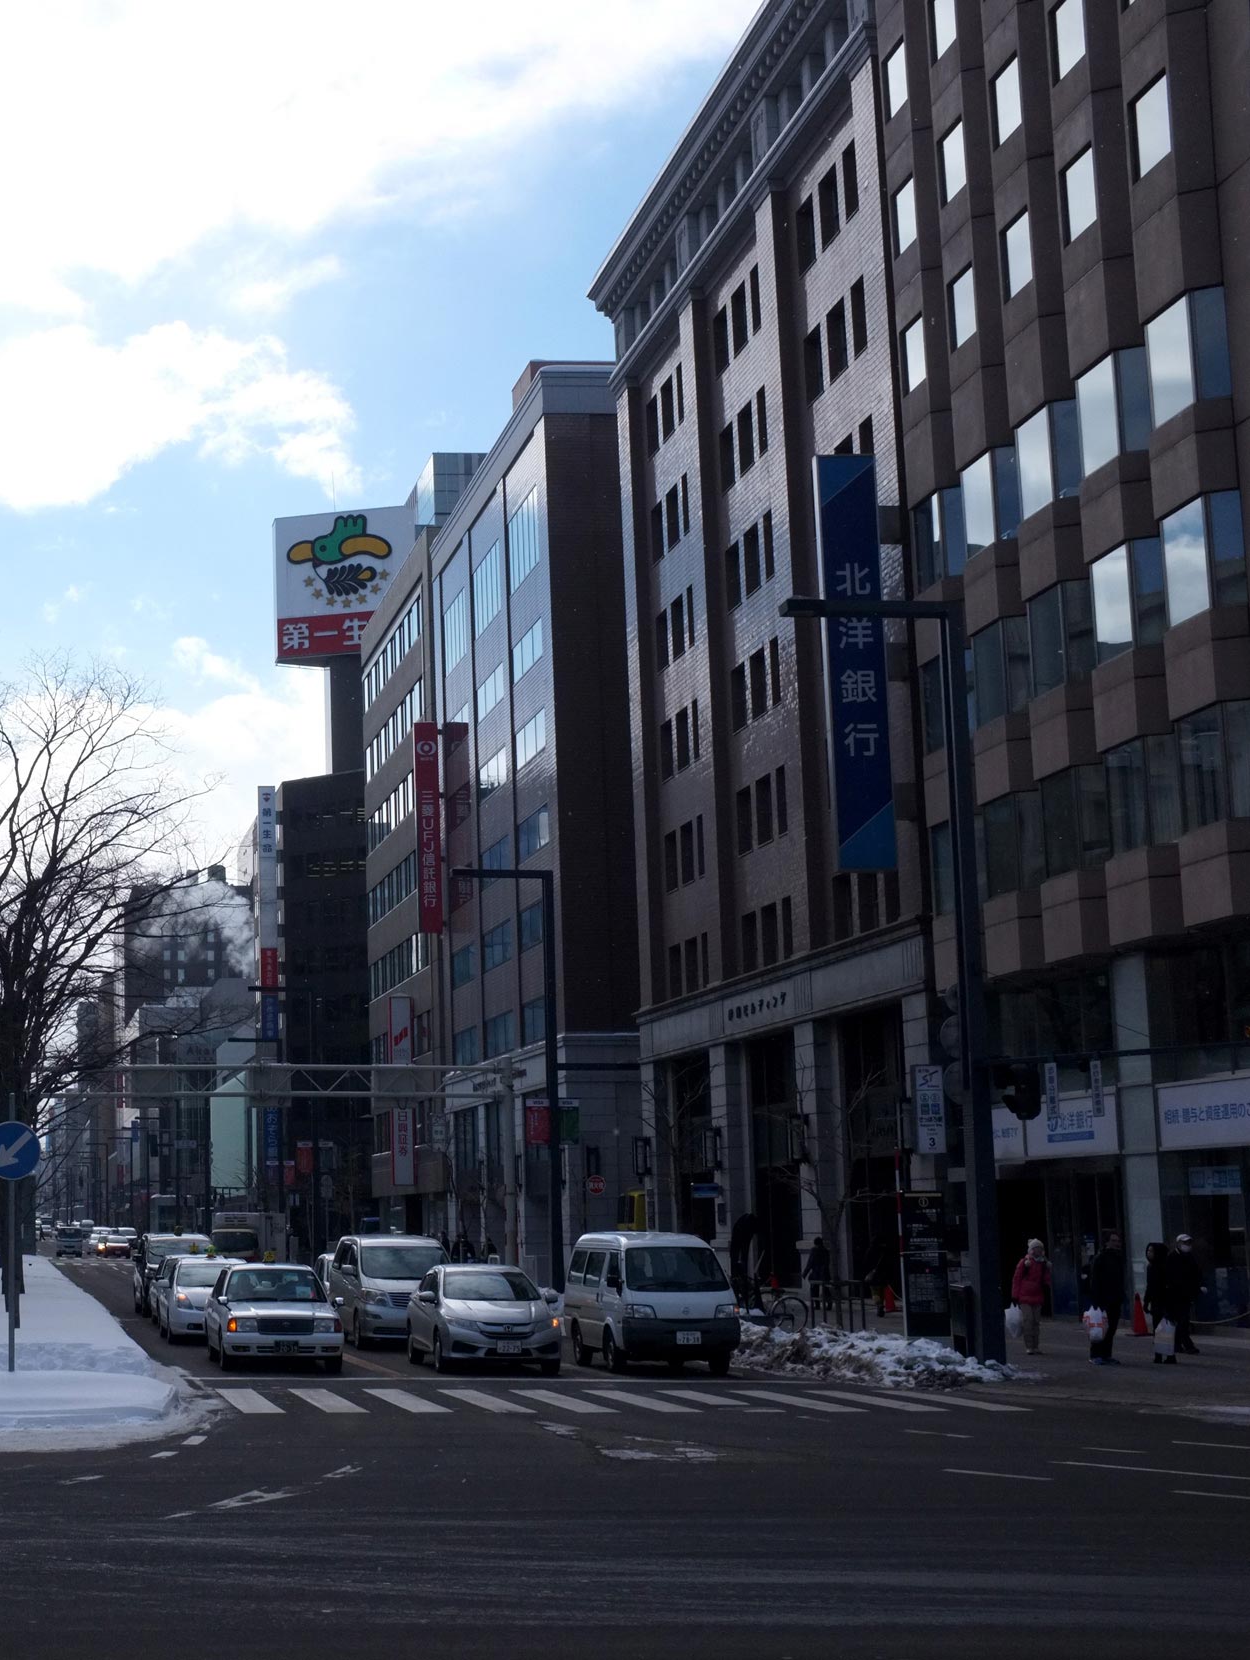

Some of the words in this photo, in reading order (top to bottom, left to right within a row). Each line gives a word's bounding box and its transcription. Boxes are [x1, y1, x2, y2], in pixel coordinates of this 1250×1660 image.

[833, 561, 879, 757] 北洋銀行
[262, 807, 273, 853] 第一生命
[420, 790, 437, 908] 三菱UFJ信託銀行
[928, 1137, 936, 1147] 3
